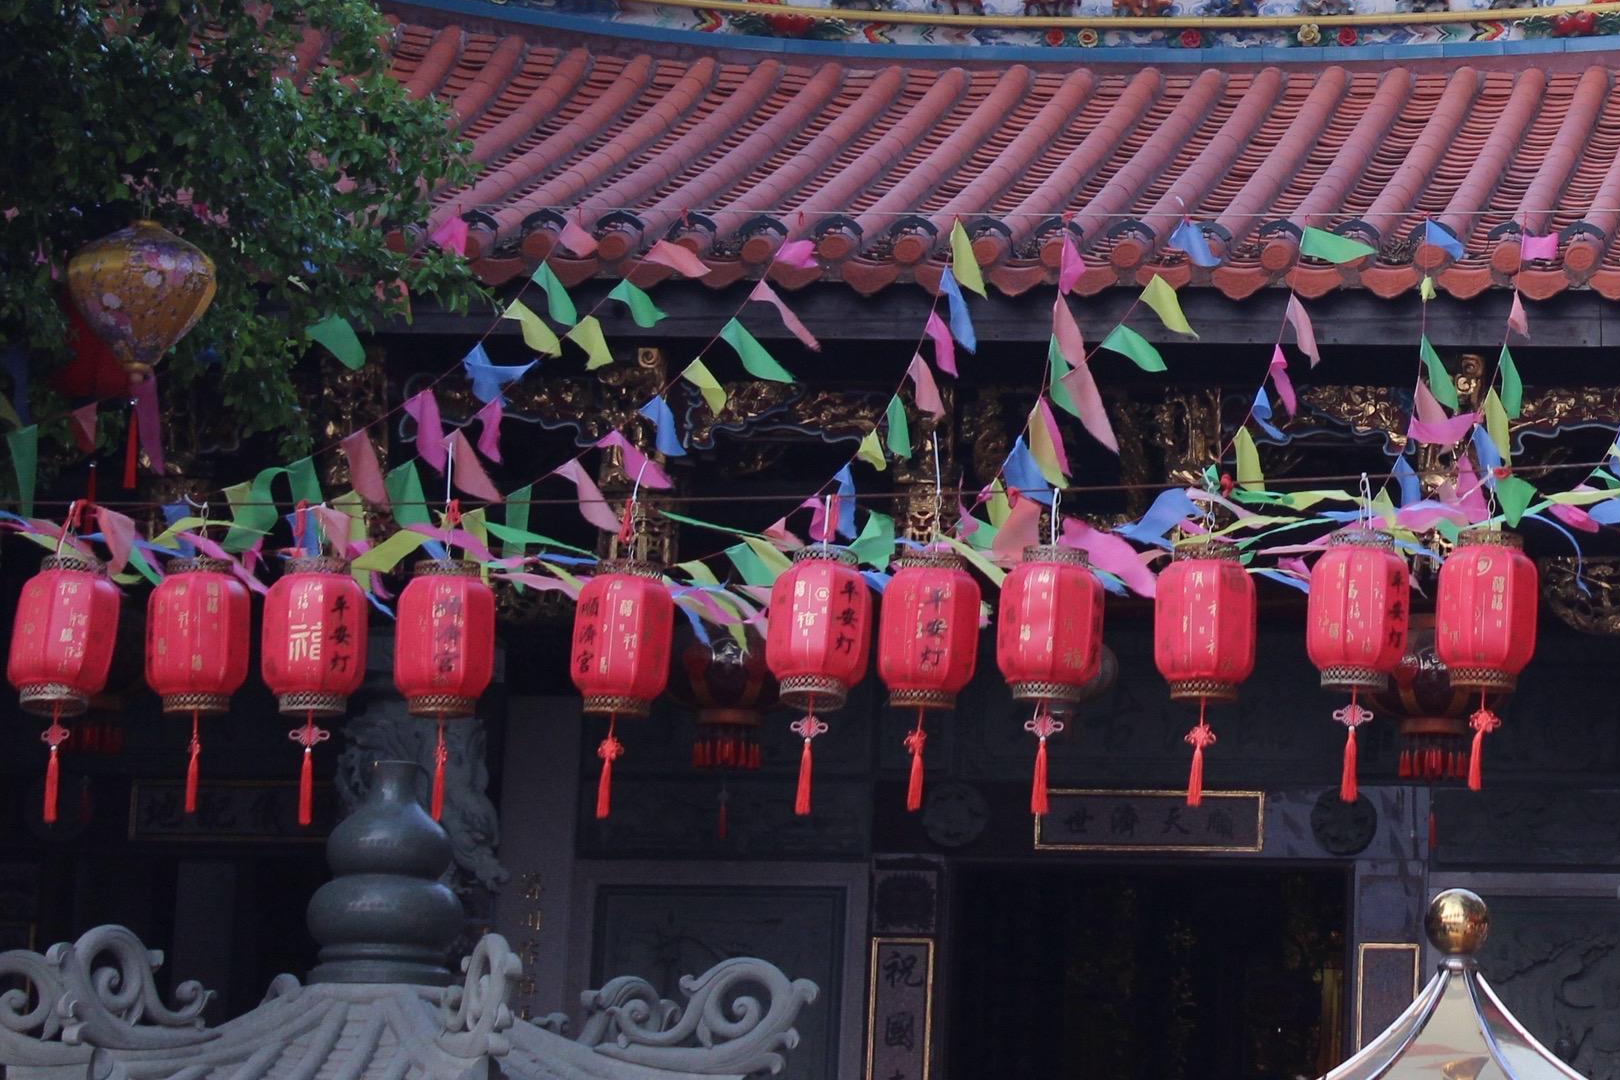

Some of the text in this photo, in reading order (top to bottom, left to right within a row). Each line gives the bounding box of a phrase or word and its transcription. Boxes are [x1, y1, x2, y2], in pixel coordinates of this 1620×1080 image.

[328, 594, 351, 673] 平安灯
[835, 580, 859, 655] 平安灯
[883, 950, 923, 1079] 祝國
